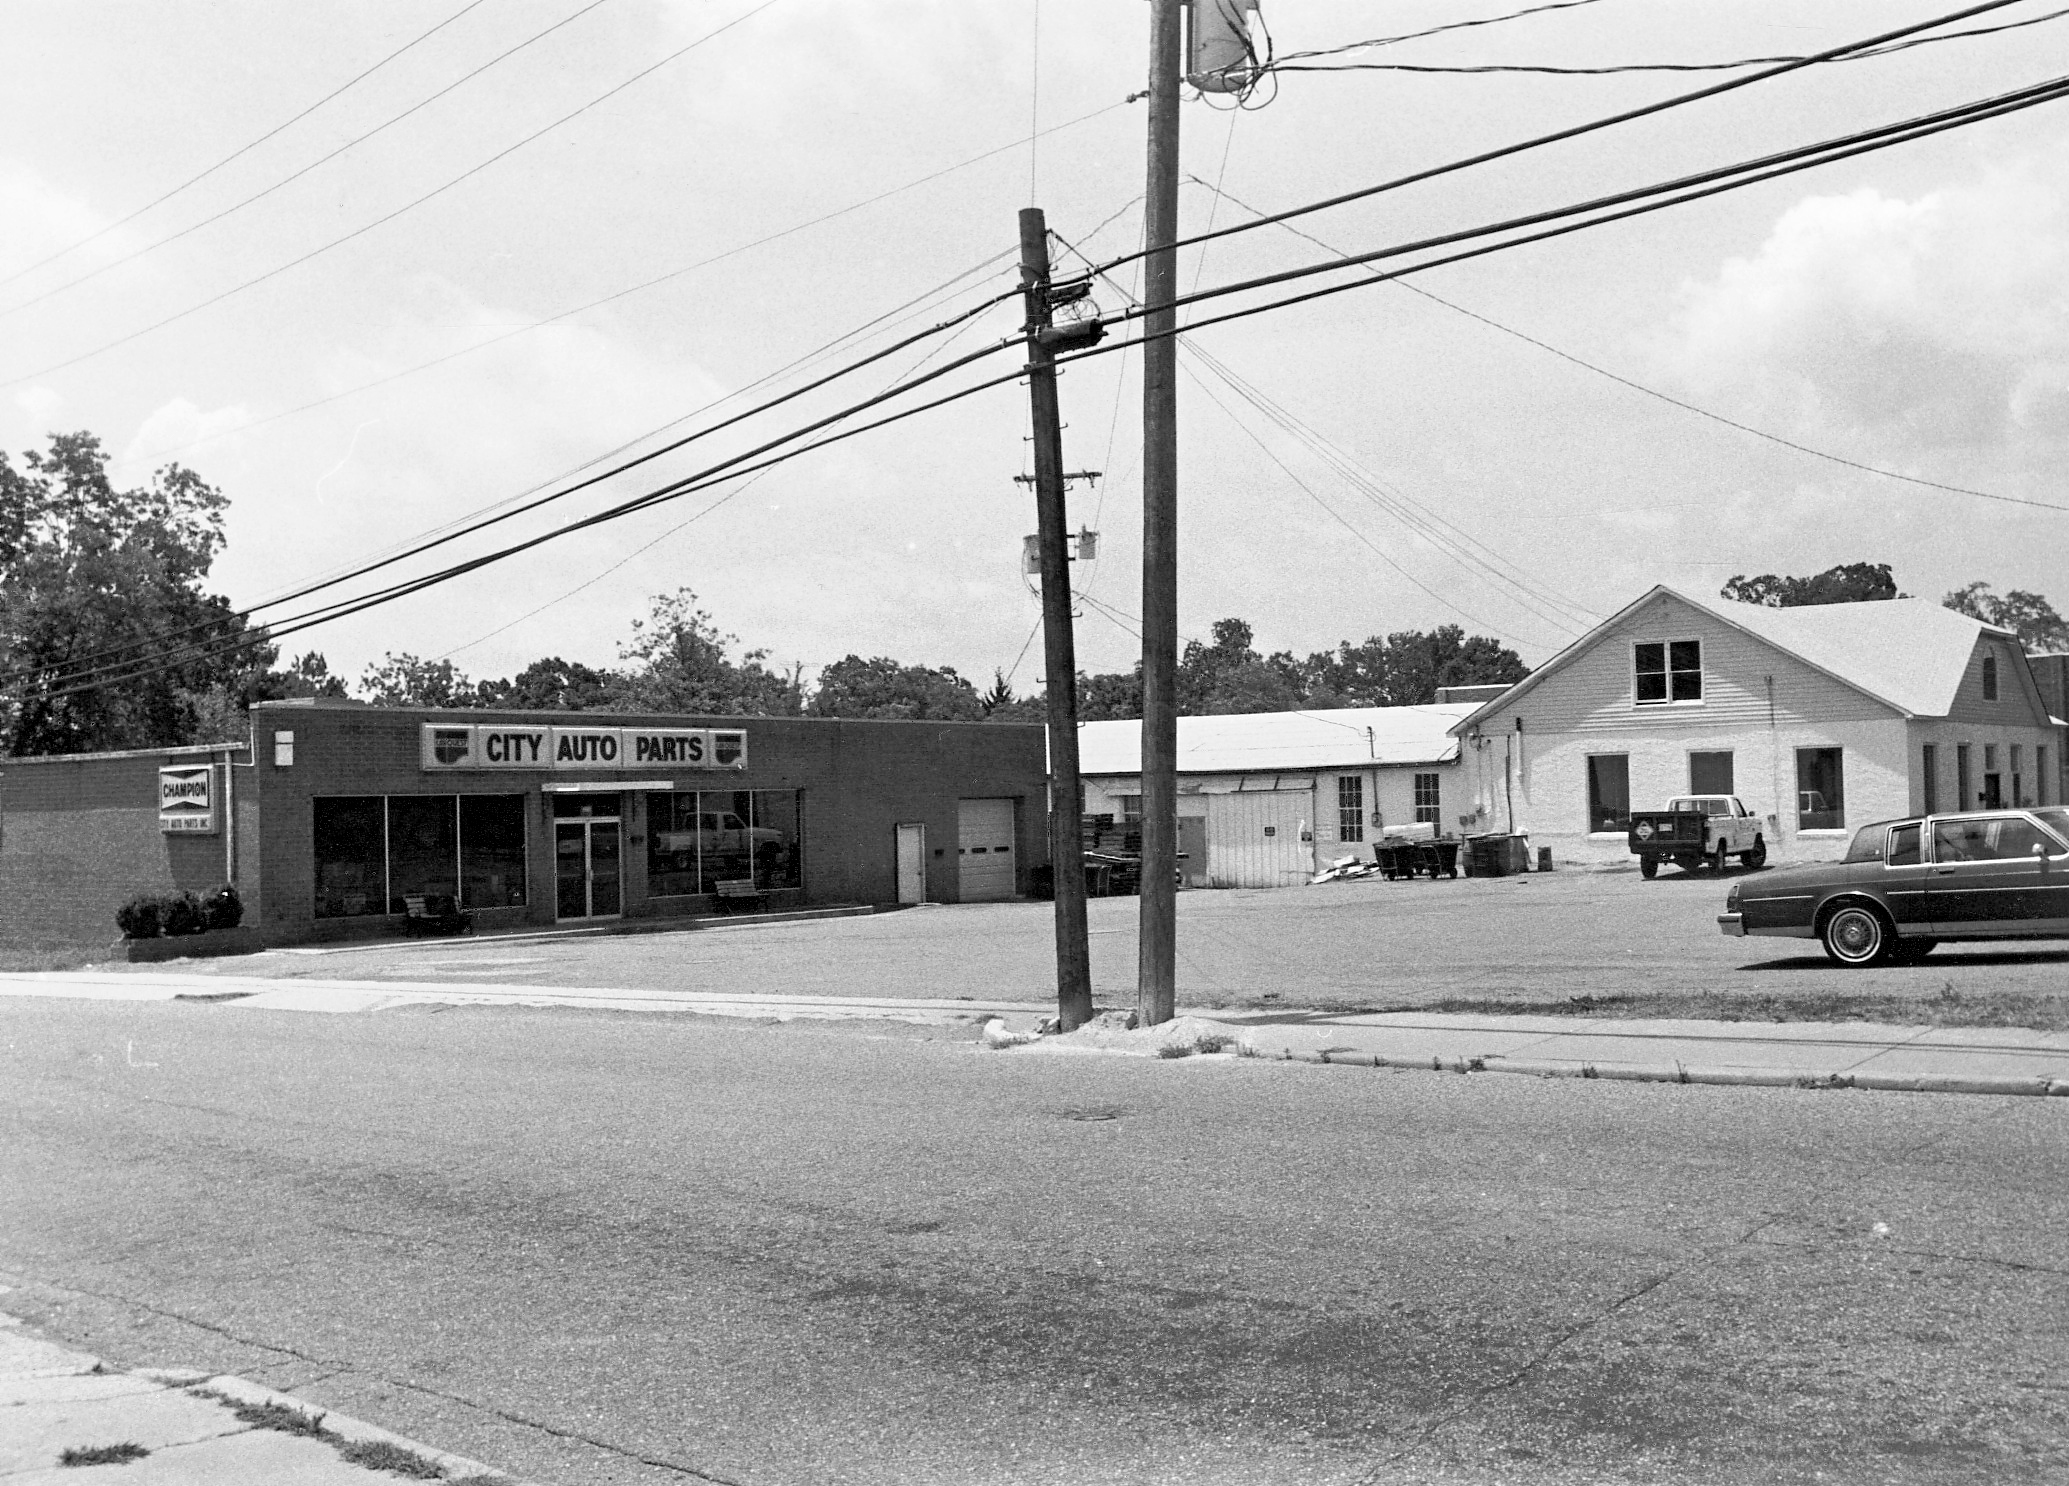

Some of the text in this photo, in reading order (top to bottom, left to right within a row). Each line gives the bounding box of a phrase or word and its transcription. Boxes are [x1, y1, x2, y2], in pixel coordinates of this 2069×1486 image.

[486, 733, 703, 762] CITY AUTO PARTS
[163, 781, 206, 798] CHAMPION
